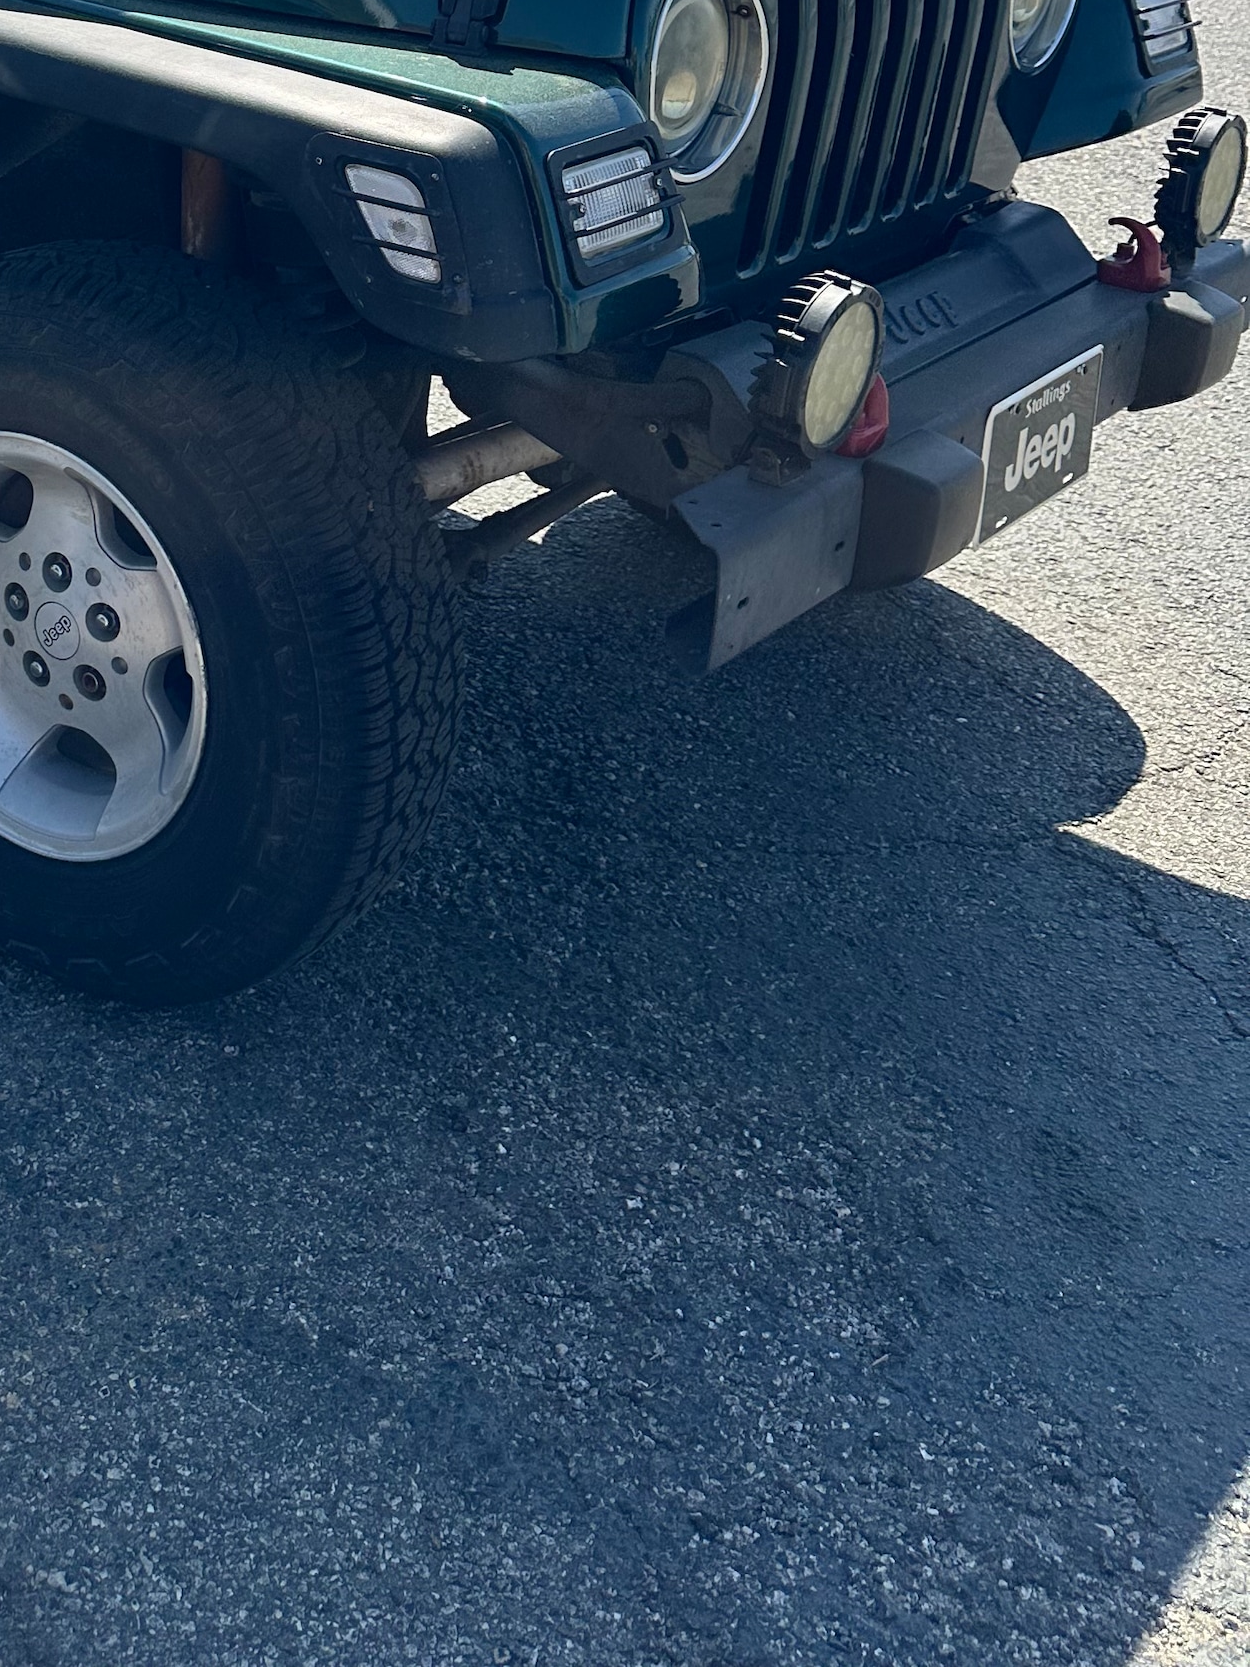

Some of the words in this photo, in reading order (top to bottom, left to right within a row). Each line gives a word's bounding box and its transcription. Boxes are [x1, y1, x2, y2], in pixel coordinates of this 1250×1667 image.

[1024, 379, 1072, 419] Stallings
[1004, 412, 1077, 493] Jeep
[42, 614, 72, 647] Jeep
